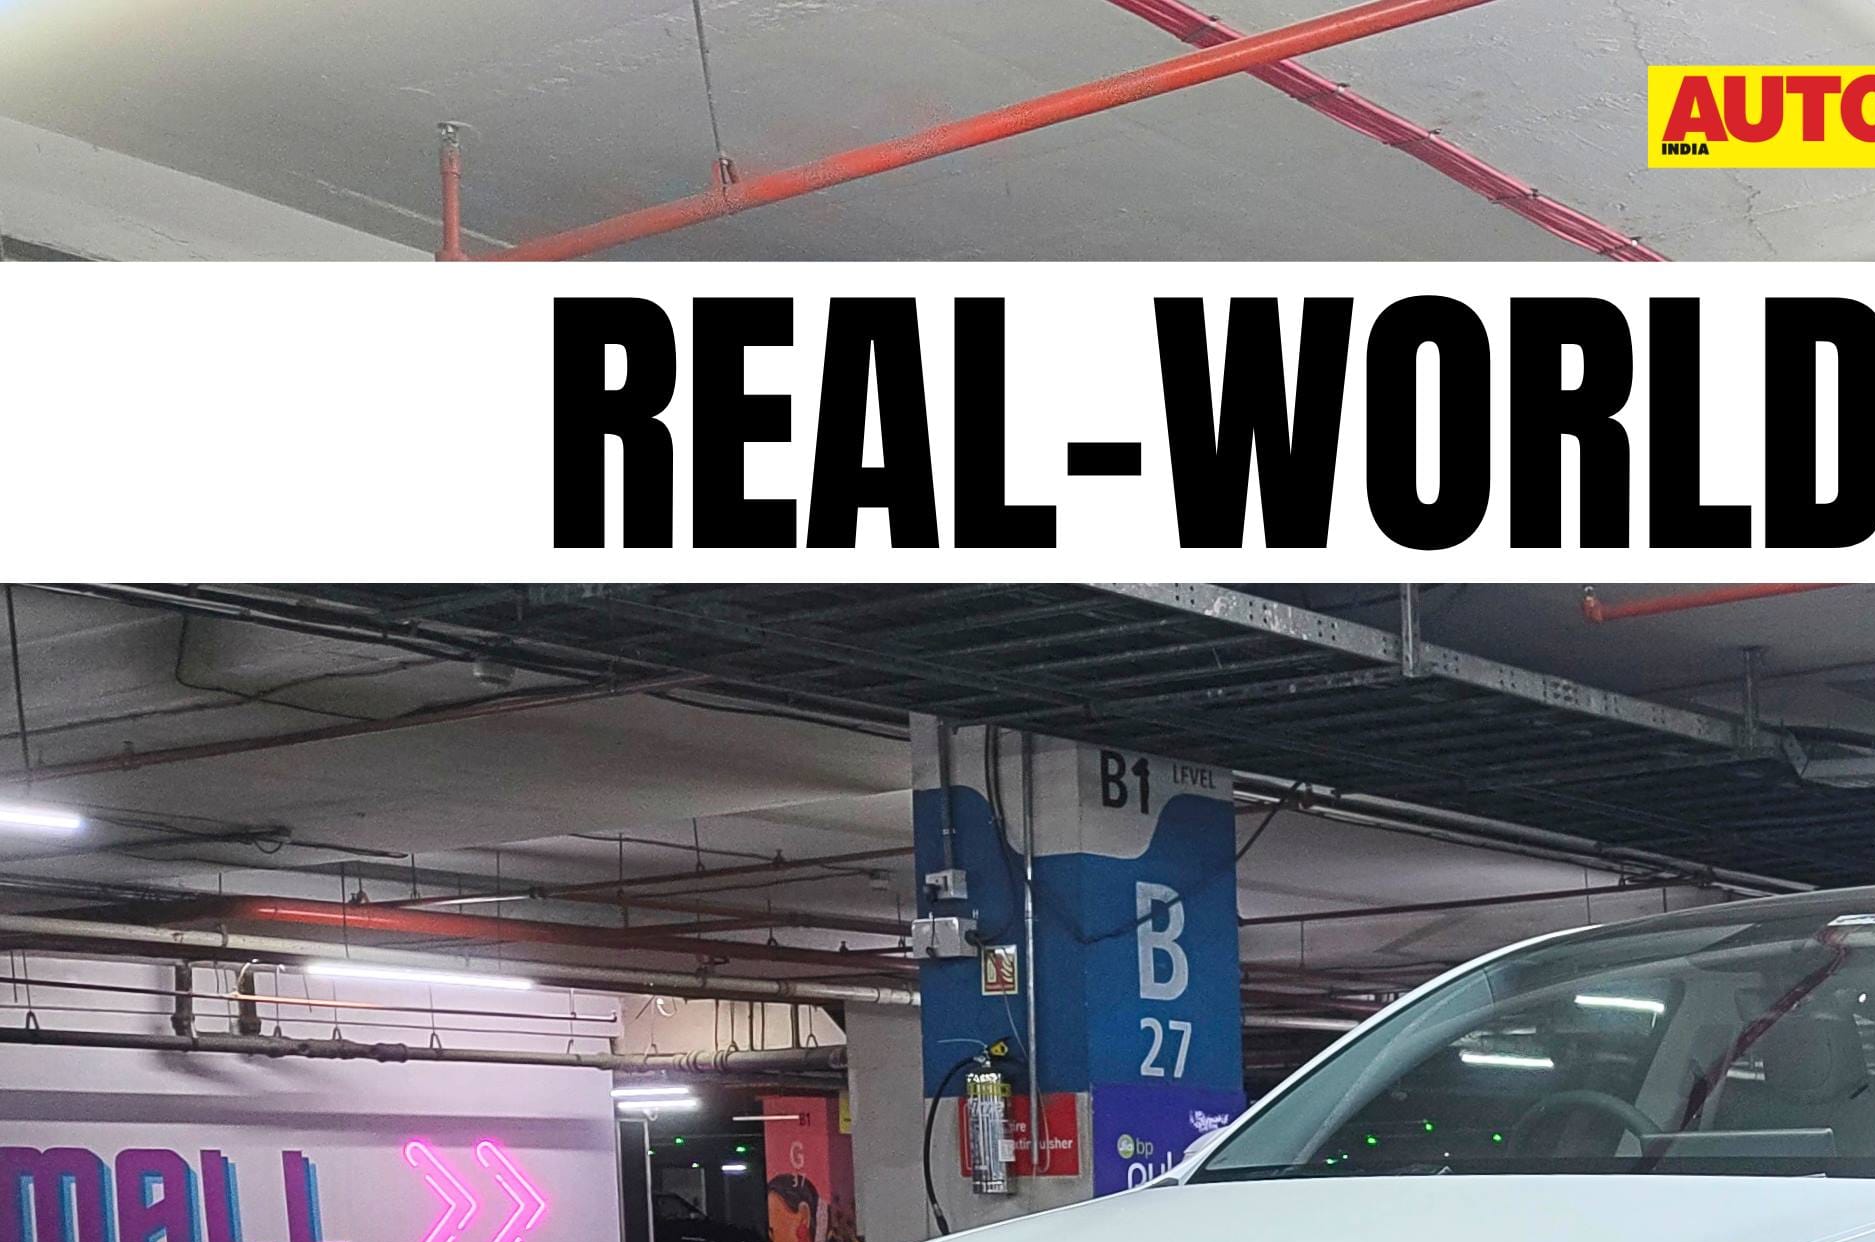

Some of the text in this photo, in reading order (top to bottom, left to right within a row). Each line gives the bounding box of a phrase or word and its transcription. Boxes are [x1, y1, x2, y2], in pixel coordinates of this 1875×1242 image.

[1100, 750, 1149, 815] B1
[1135, 880, 1188, 1001] B
[1139, 1017, 1192, 1079] 27
[790, 1141, 805, 1169] G
[1136, 1137, 1154, 1158] bp
